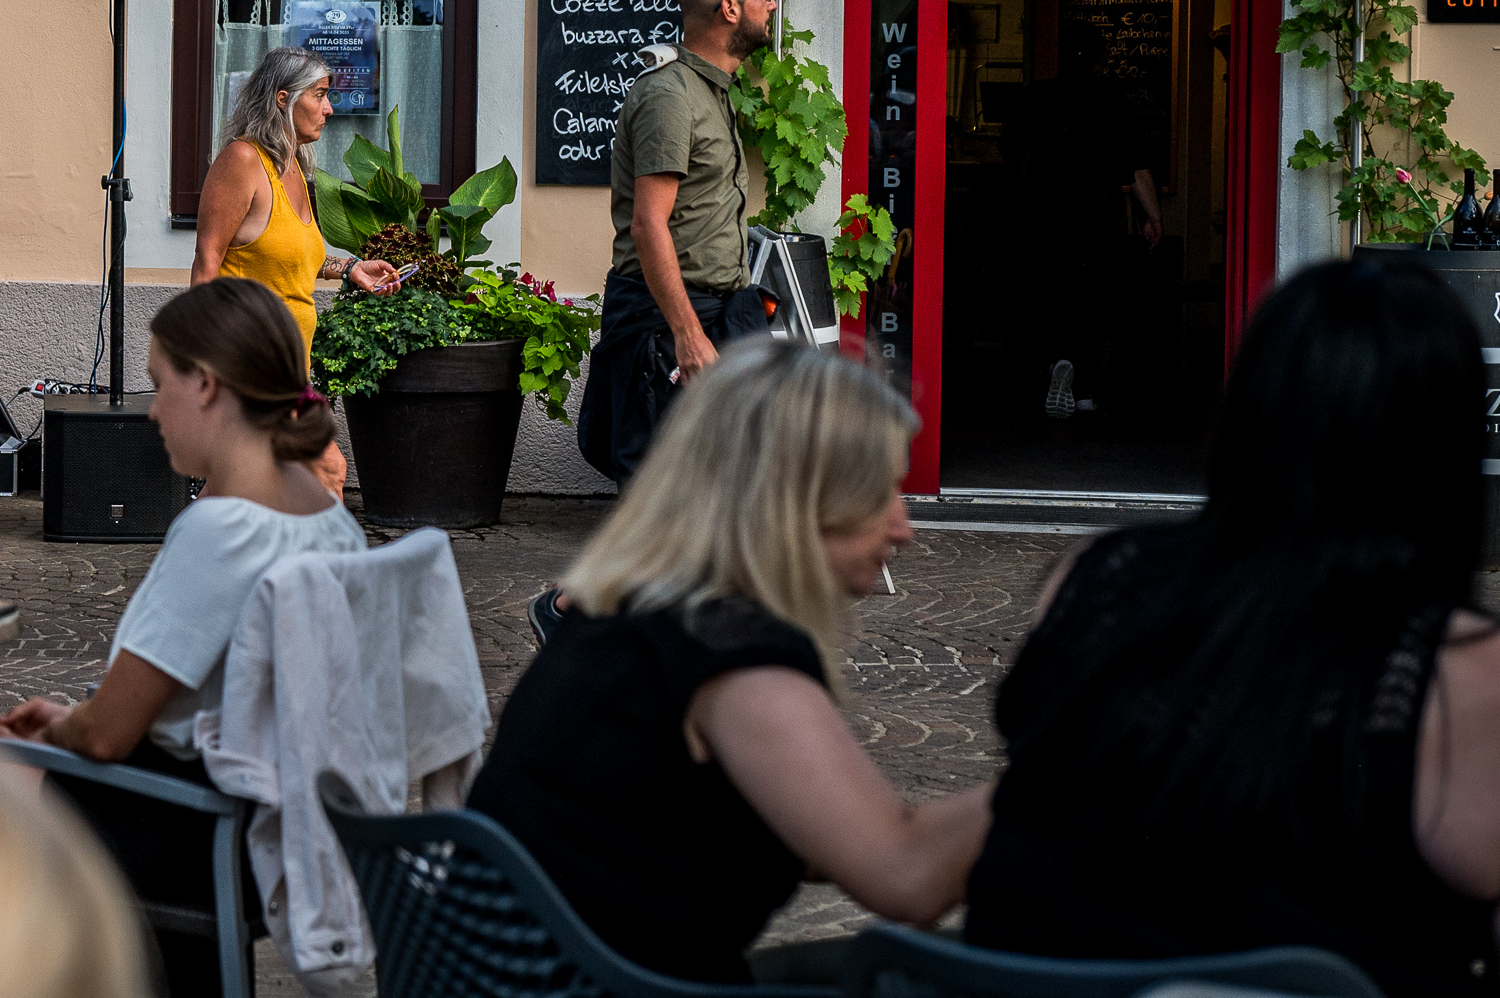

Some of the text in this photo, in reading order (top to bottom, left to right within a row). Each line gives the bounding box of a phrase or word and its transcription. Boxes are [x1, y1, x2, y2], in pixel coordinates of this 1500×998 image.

[561, 21, 684, 45] buzzara €1
[555, 70, 636, 98] Filetste
[882, 22, 908, 120] Wein
